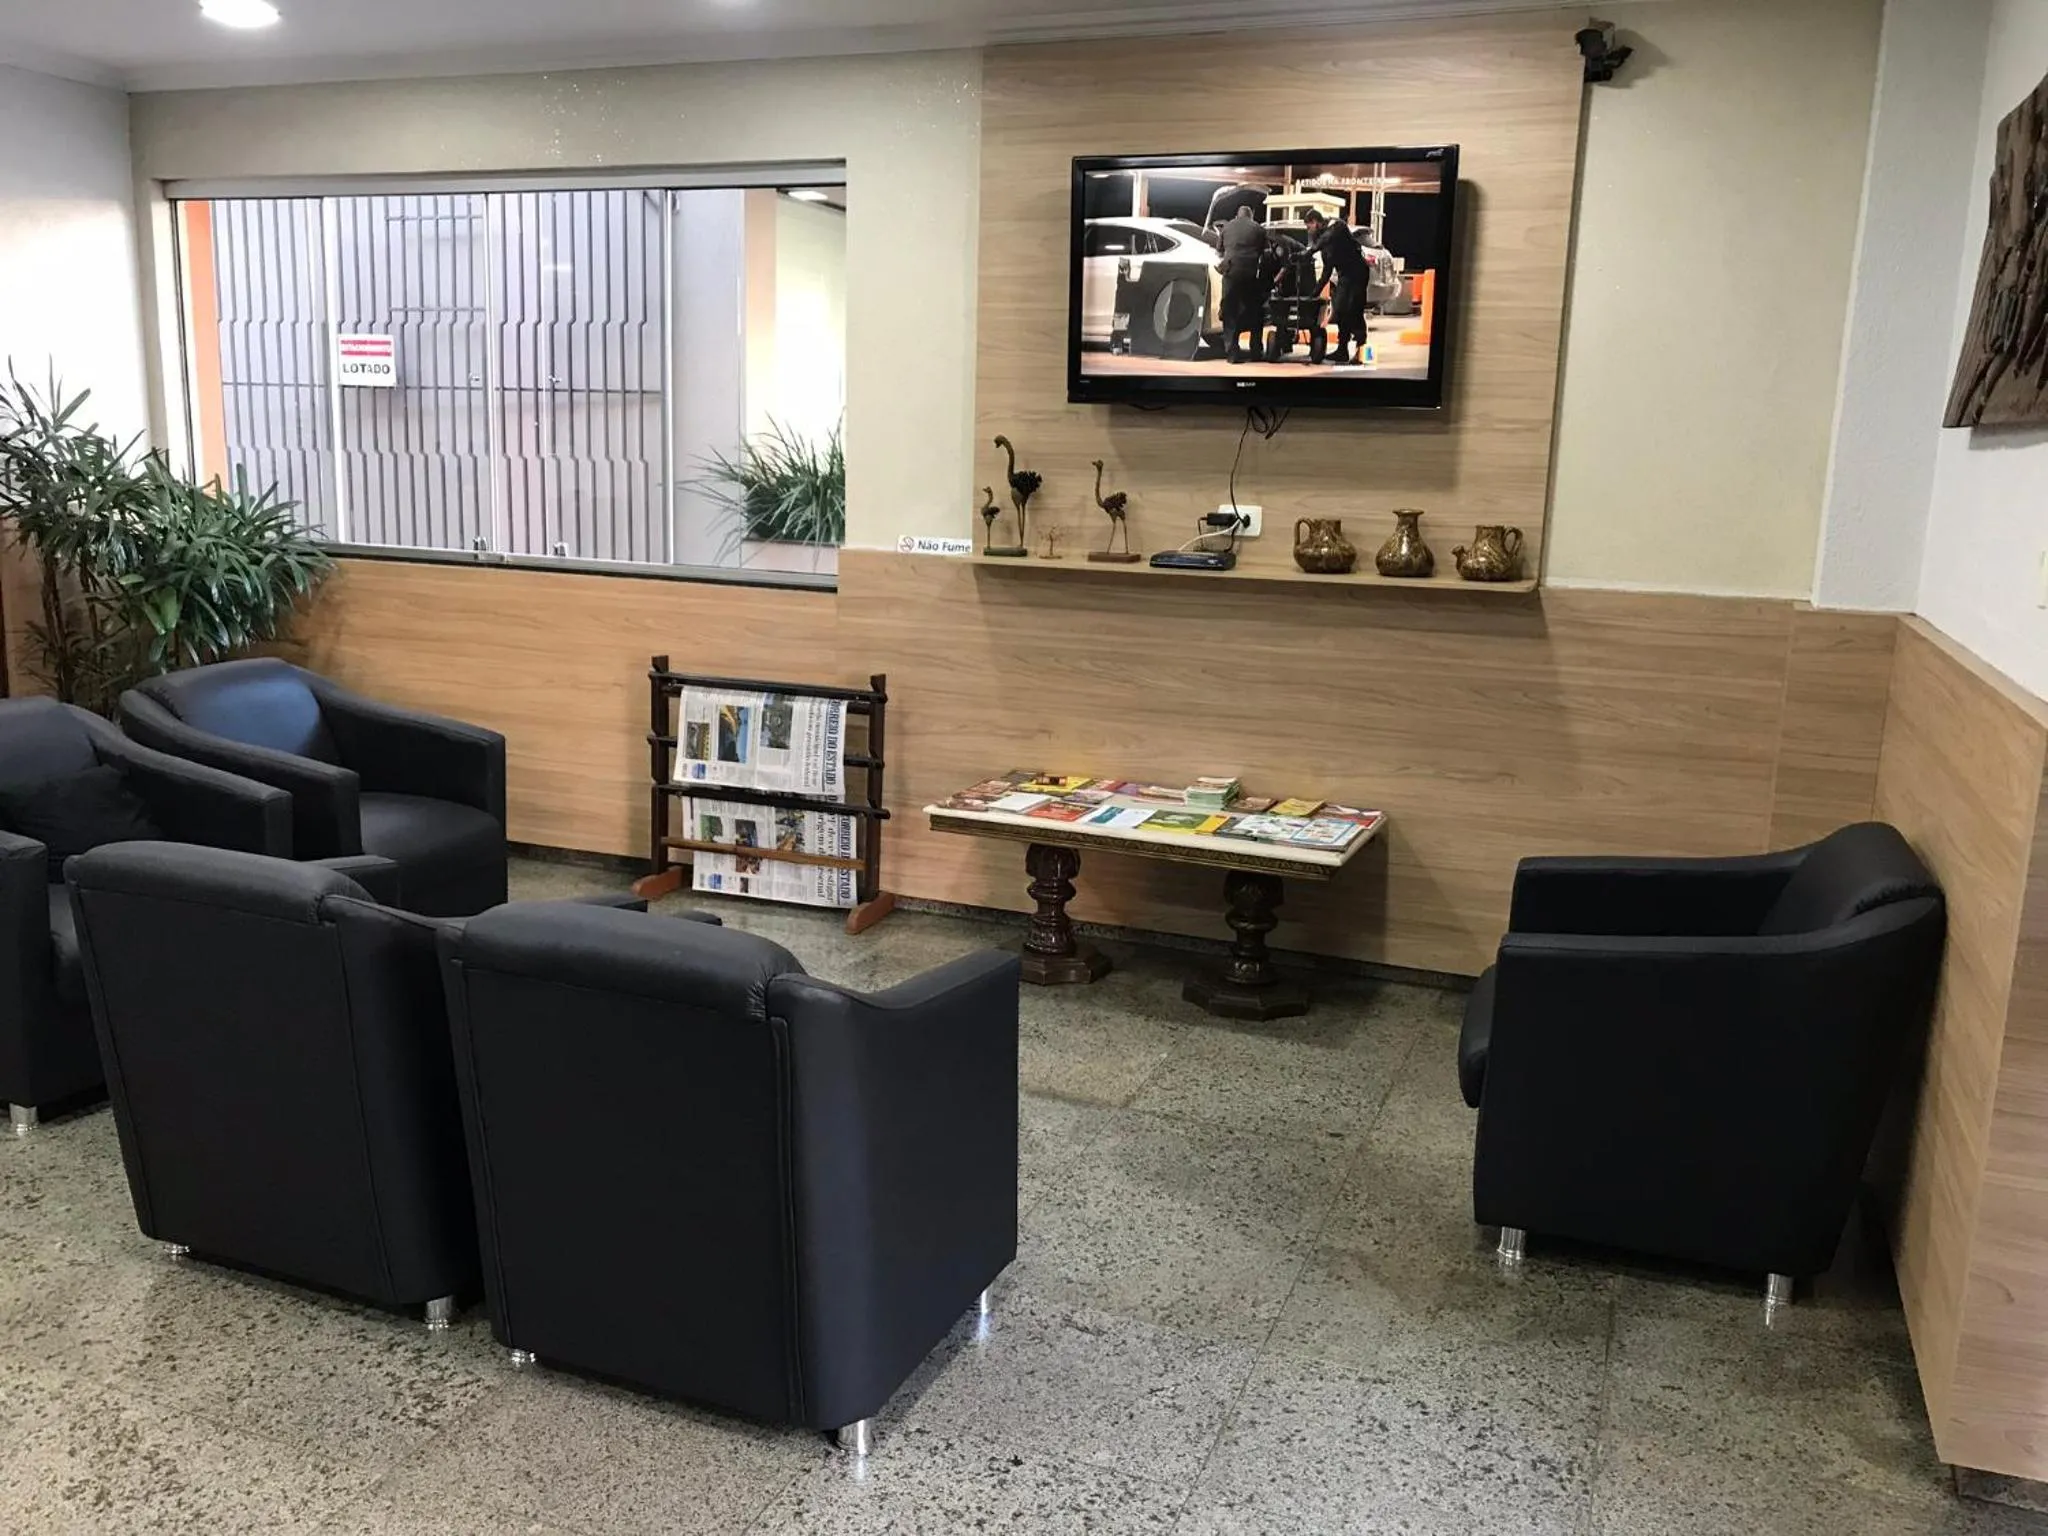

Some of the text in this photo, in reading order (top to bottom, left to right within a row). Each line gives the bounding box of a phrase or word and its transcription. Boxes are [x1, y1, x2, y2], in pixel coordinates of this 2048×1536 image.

[342, 363, 391, 375] LOTADO
[918, 540, 971, 553] Não Fume
[826, 750, 838, 785] ESTADO
